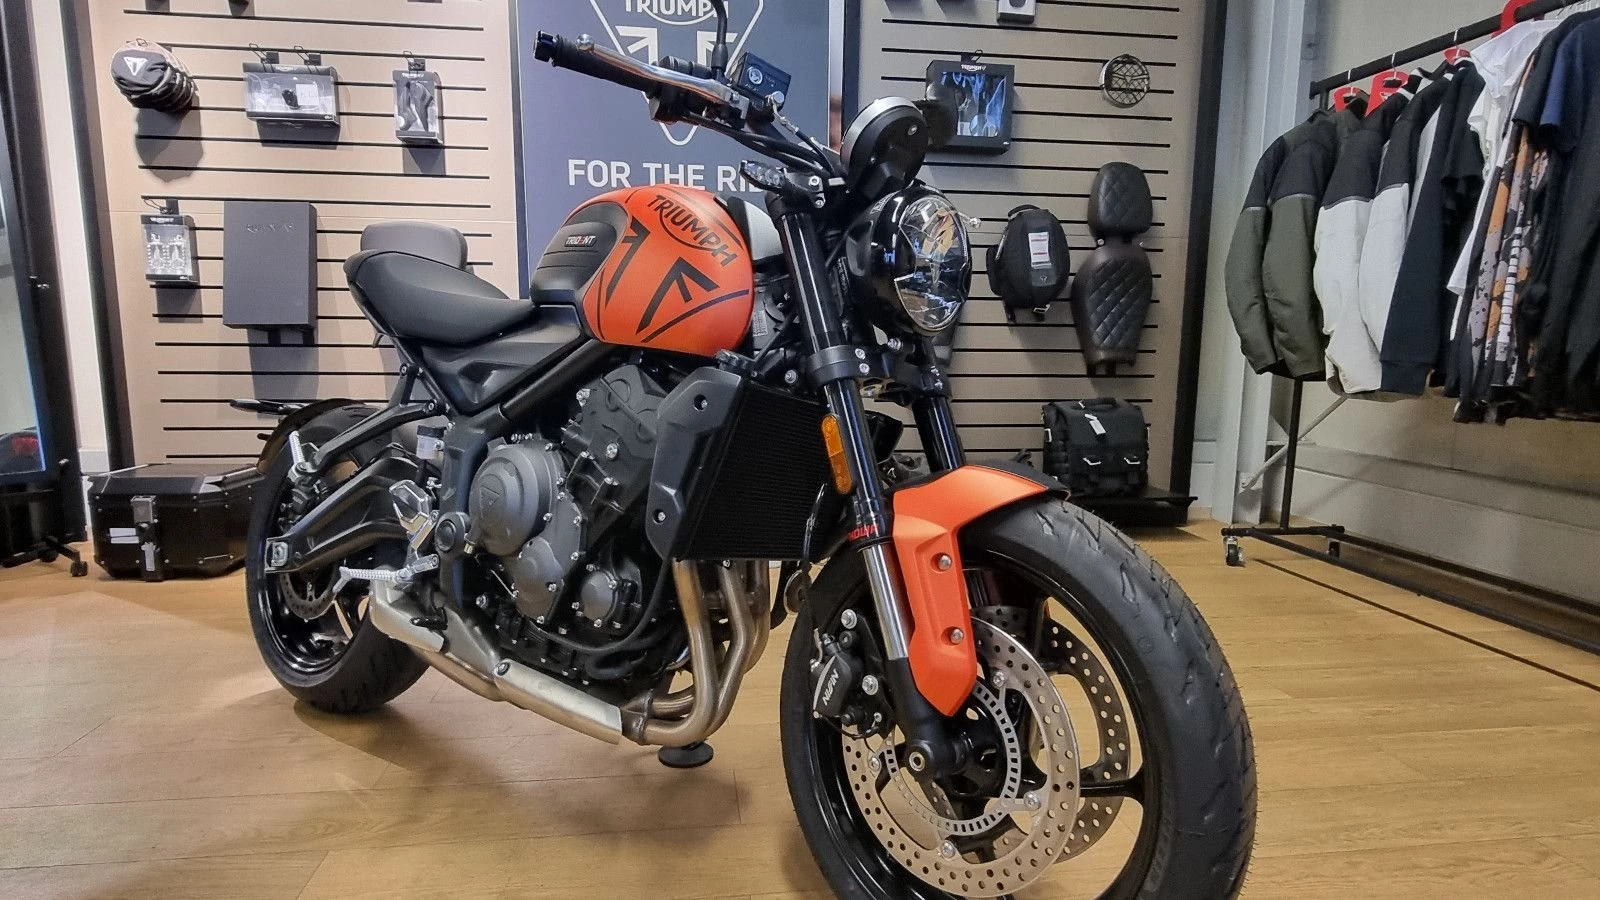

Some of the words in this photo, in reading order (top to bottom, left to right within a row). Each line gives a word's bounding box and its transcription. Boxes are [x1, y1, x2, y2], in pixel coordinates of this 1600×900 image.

[568, 159, 632, 188] FOR
[643, 162, 706, 190] THE
[647, 194, 738, 267] TRIUMPH
